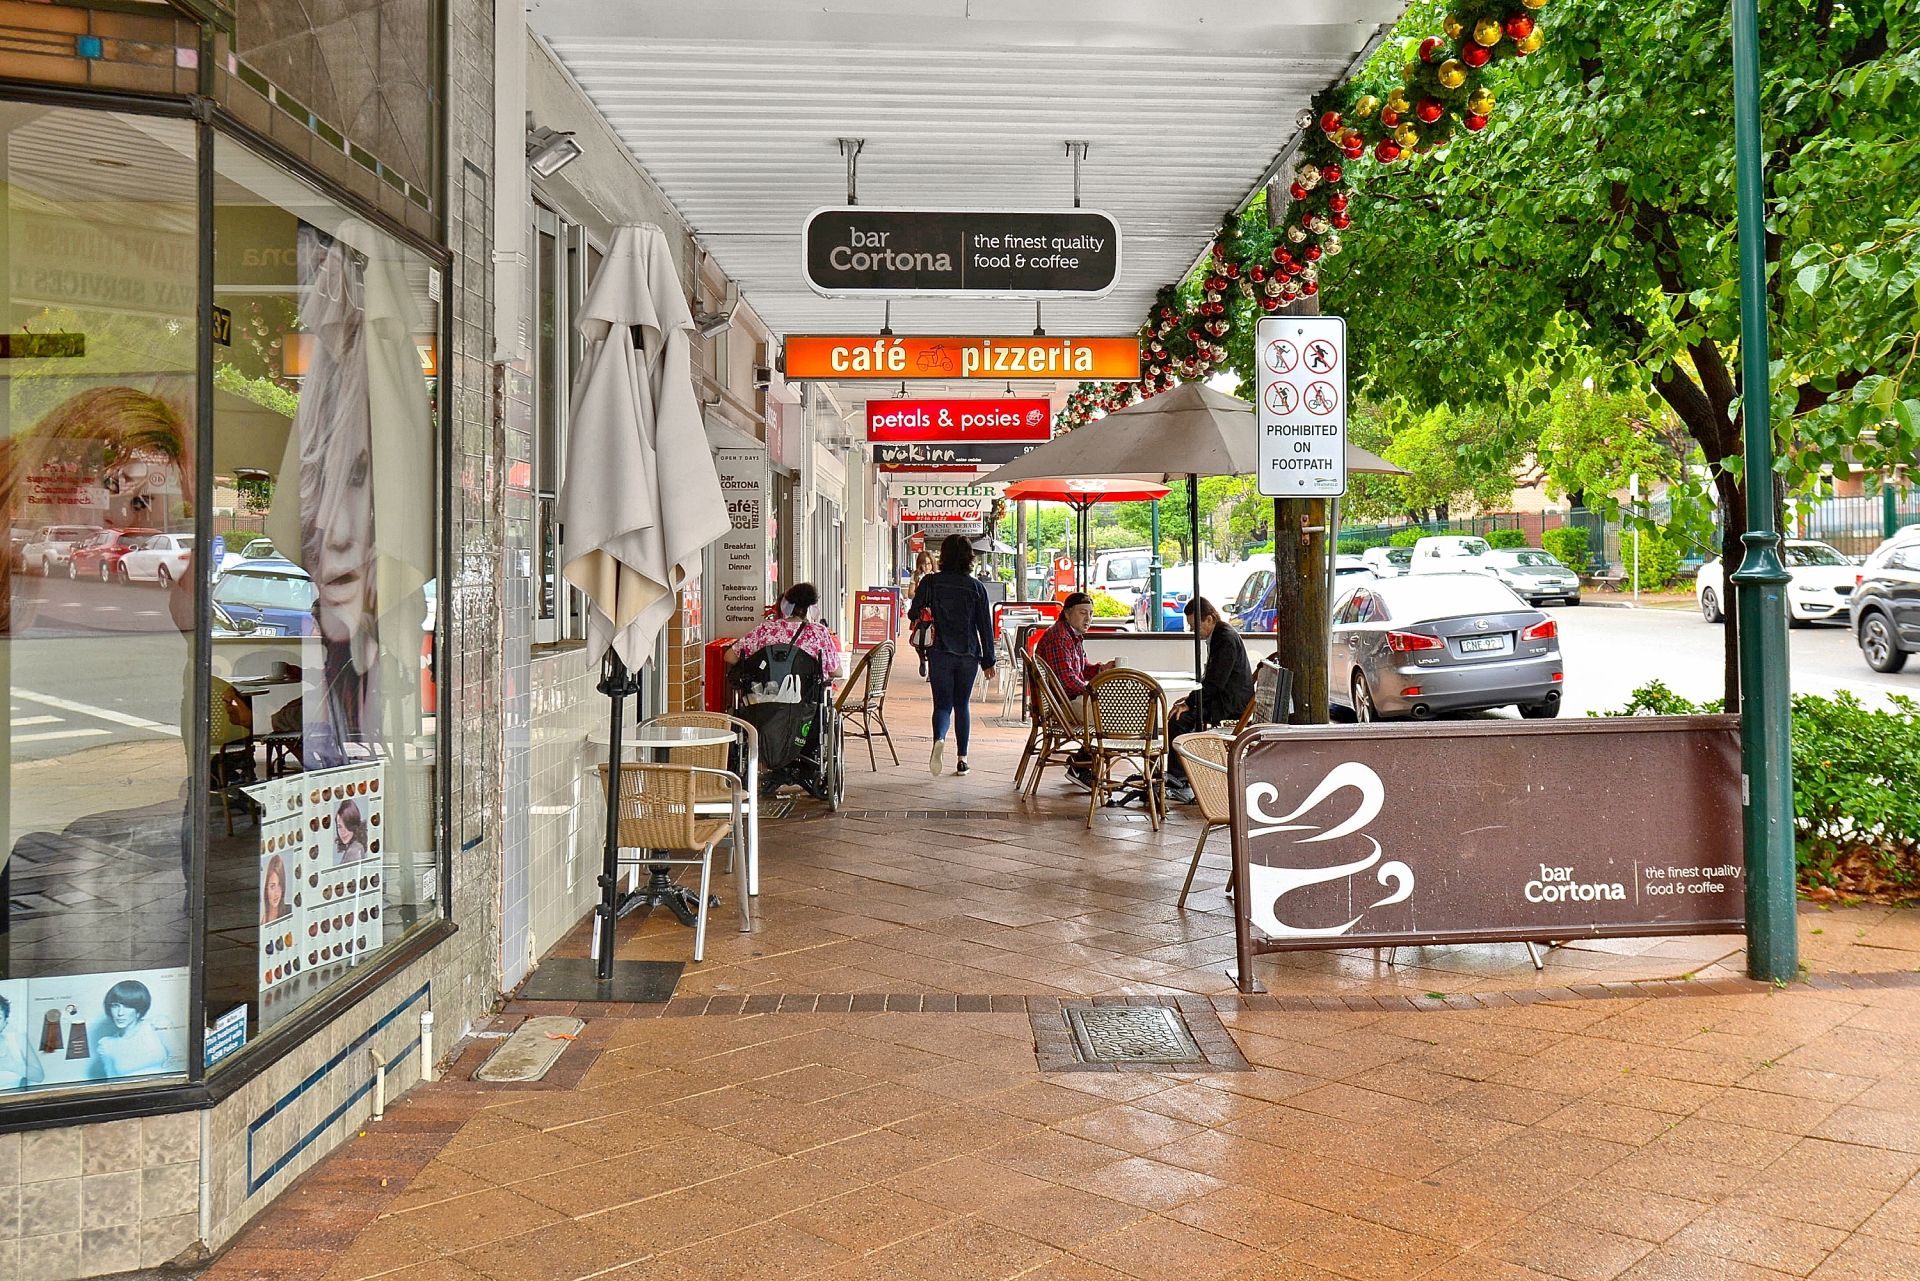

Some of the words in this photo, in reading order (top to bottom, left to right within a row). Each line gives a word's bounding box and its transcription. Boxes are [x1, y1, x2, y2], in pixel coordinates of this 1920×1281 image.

[850, 227, 890, 247] bar
[974, 234, 999, 248] the
[1004, 234, 1047, 248] finest
[1050, 235, 1104, 252] quality
[830, 247, 952, 271] Cortona
[974, 254, 1010, 268] food
[1014, 254, 1026, 268] &
[1030, 254, 1078, 268] coffee
[831, 339, 906, 372] café
[962, 340, 1093, 377] pizzeria
[872, 408, 930, 432] petals
[938, 408, 953, 426] &
[962, 408, 1020, 431] posies
[1267, 425, 1338, 436] PROHIBITED
[1294, 442, 1310, 452] ON
[1272, 459, 1332, 470] FOOTPATH
[903, 486, 996, 496] BUTCHER
[725, 500, 751, 512] afé
[918, 498, 982, 510] pharmacy
[1540, 864, 1574, 882] bar
[1646, 867, 1664, 879] the
[1668, 866, 1700, 878] finest
[1702, 864, 1741, 883] quality
[1524, 881, 1626, 903] Cortona
[1646, 884, 1673, 896] food
[1676, 883, 1685, 894] &
[1688, 882, 1724, 894] coffee
